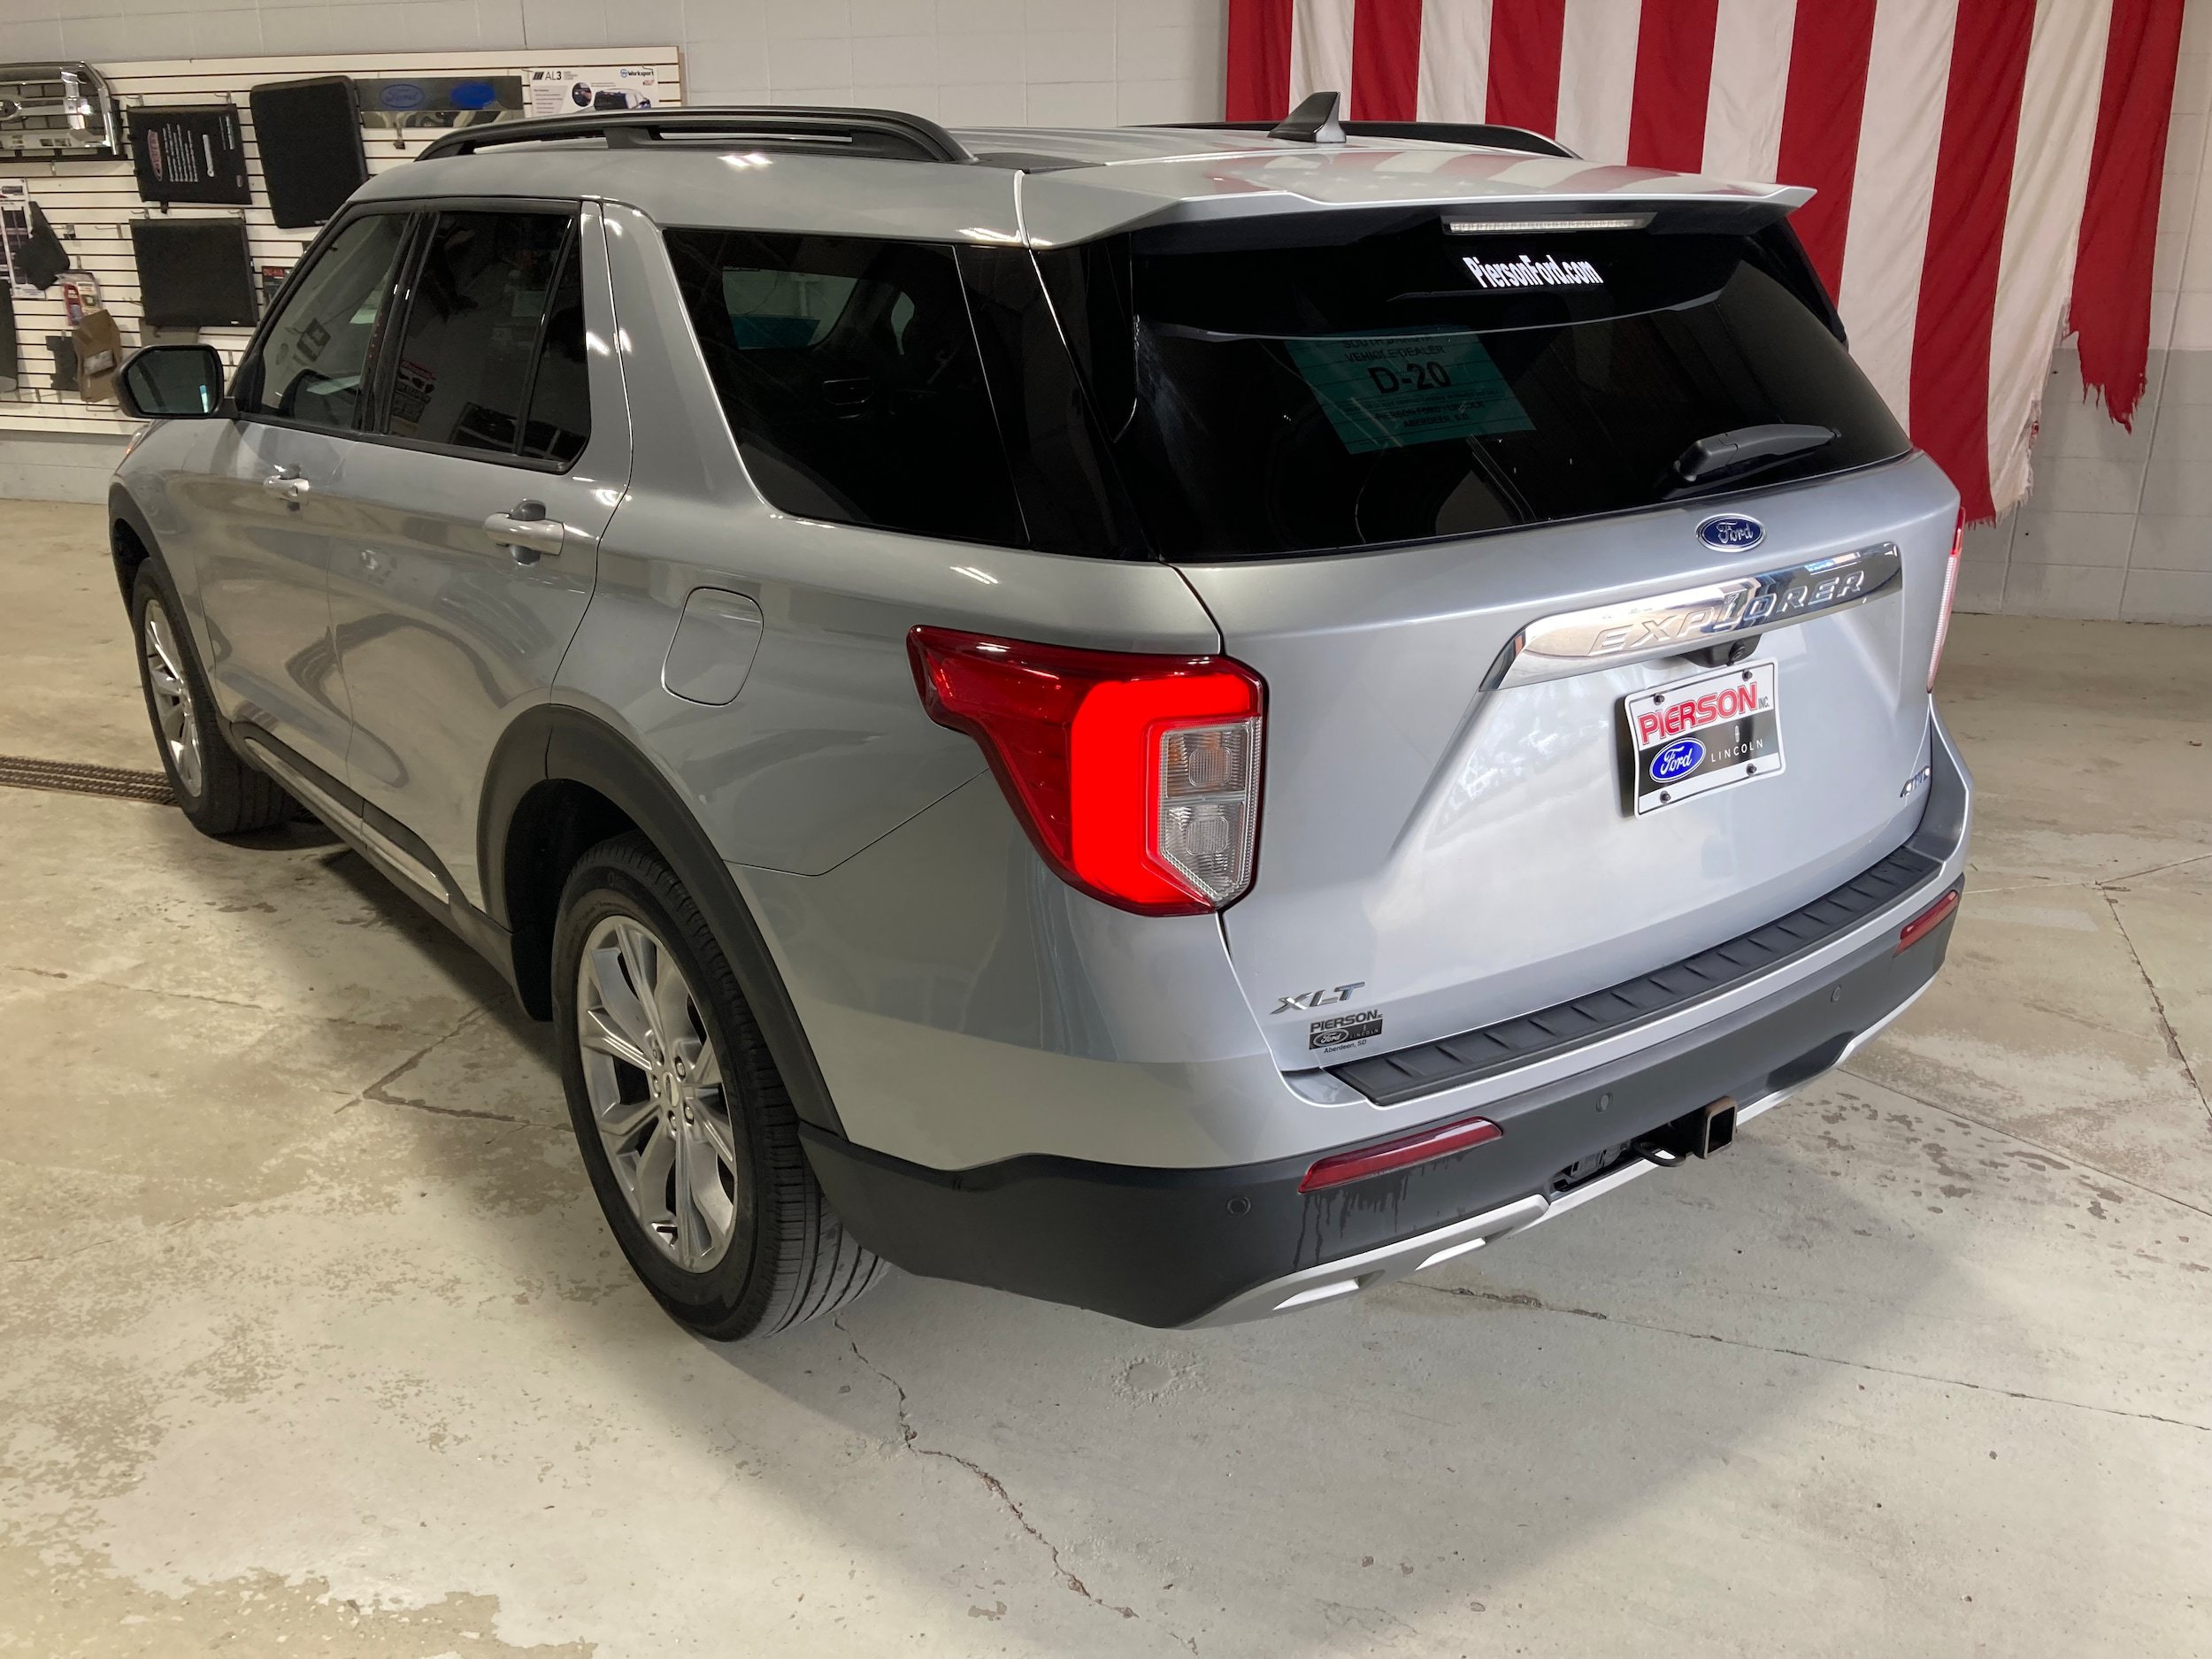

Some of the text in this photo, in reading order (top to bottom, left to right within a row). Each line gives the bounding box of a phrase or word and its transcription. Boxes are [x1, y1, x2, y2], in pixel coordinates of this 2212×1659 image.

[545, 71, 562, 81] AL3
[1463, 255, 1603, 288] PiersonFord.com
[1399, 345, 1446, 357] DEALER
[1367, 362, 1451, 394] D-20
[1716, 521, 1755, 545] Ford
[1587, 571, 1864, 657] EXPLORER
[1638, 681, 1770, 745] PIERSON INC.
[1660, 746, 1693, 775] Ford
[1711, 739, 1763, 763] LINCOLN
[1269, 981, 1364, 1015] XLT
[1310, 1010, 1379, 1033] PIERSON
[1320, 1031, 1341, 1043] Ford
[1350, 1029, 1379, 1039] LINCOLN
[1324, 1043, 1356, 1054] Aberdeen,
